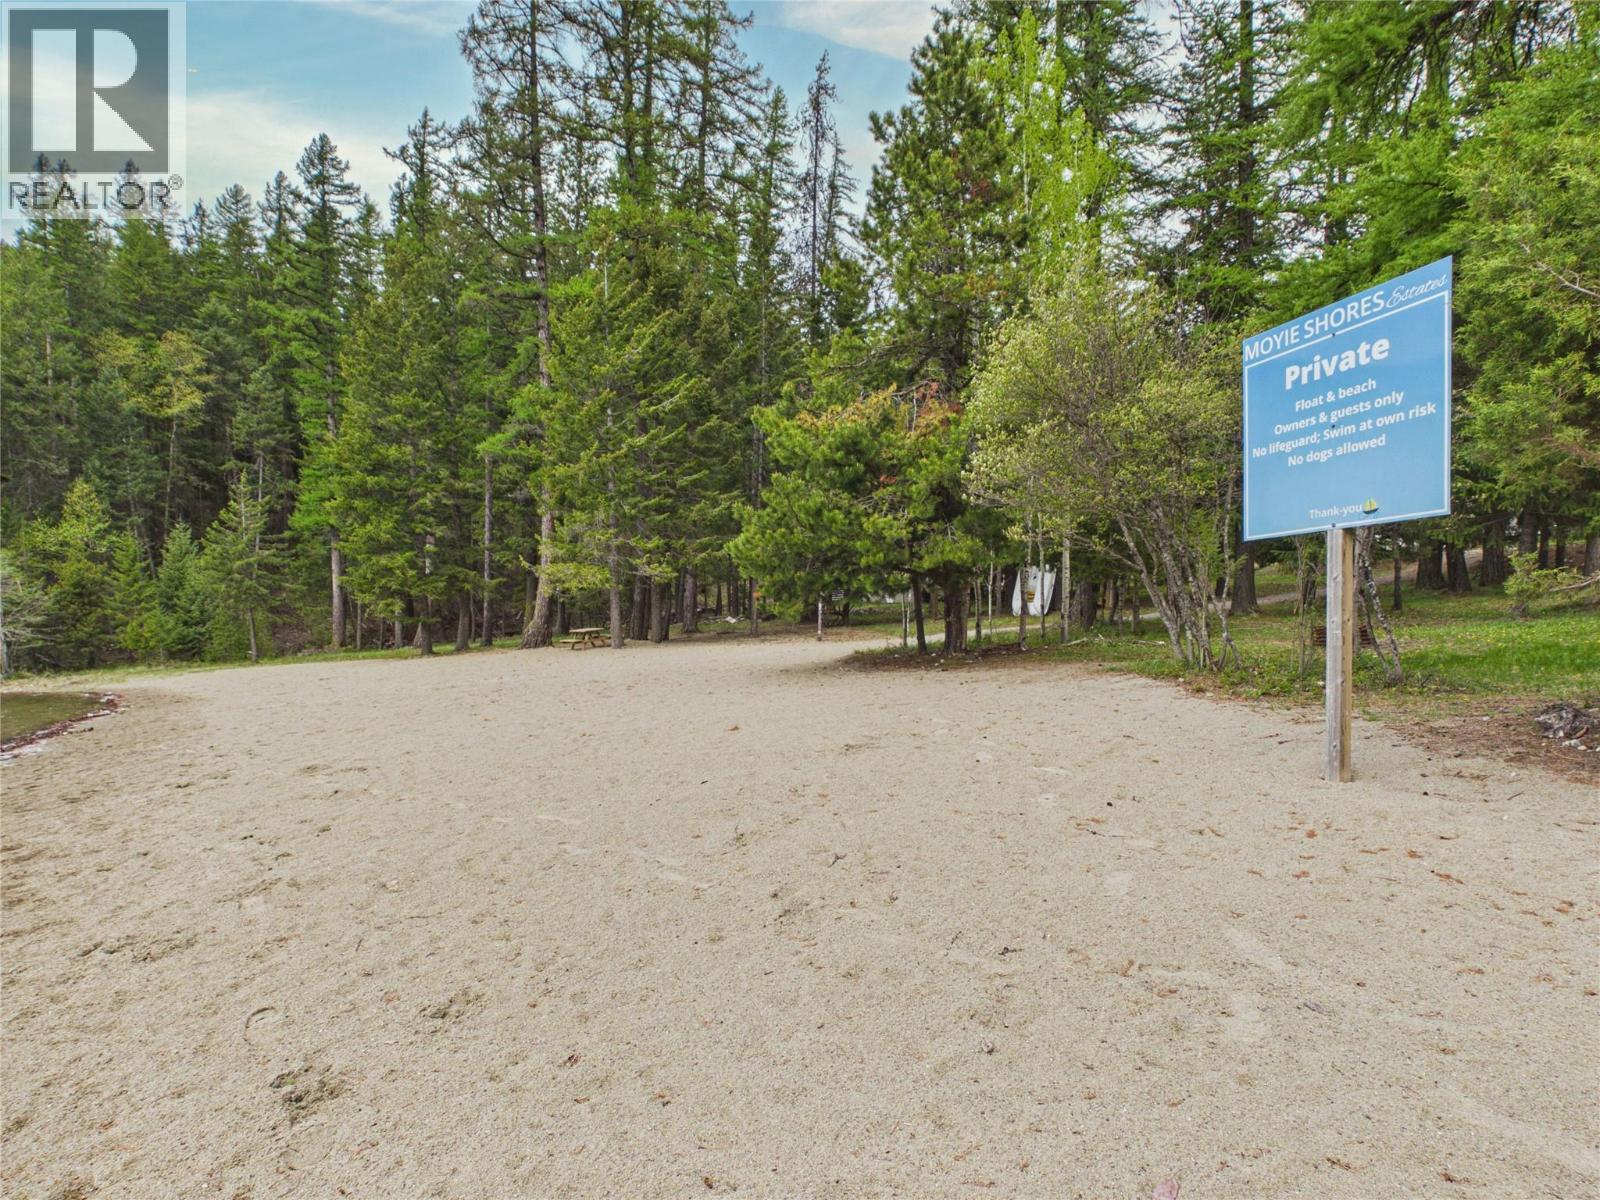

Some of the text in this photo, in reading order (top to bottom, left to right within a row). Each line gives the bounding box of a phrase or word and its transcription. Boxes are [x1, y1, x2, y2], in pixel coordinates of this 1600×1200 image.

[1244, 325, 1299, 361] MOYIE
[1304, 291, 1384, 338] SHORES
[1285, 338, 1390, 390] Private
[1275, 390, 1404, 435] Owners & guests only
[1296, 379, 1376, 412] Float & beach
[1252, 402, 1436, 458] No lifeguard; Swim at own risk
[1288, 434, 1386, 467] No dogs allowed
[1309, 503, 1362, 519] Thank-you
